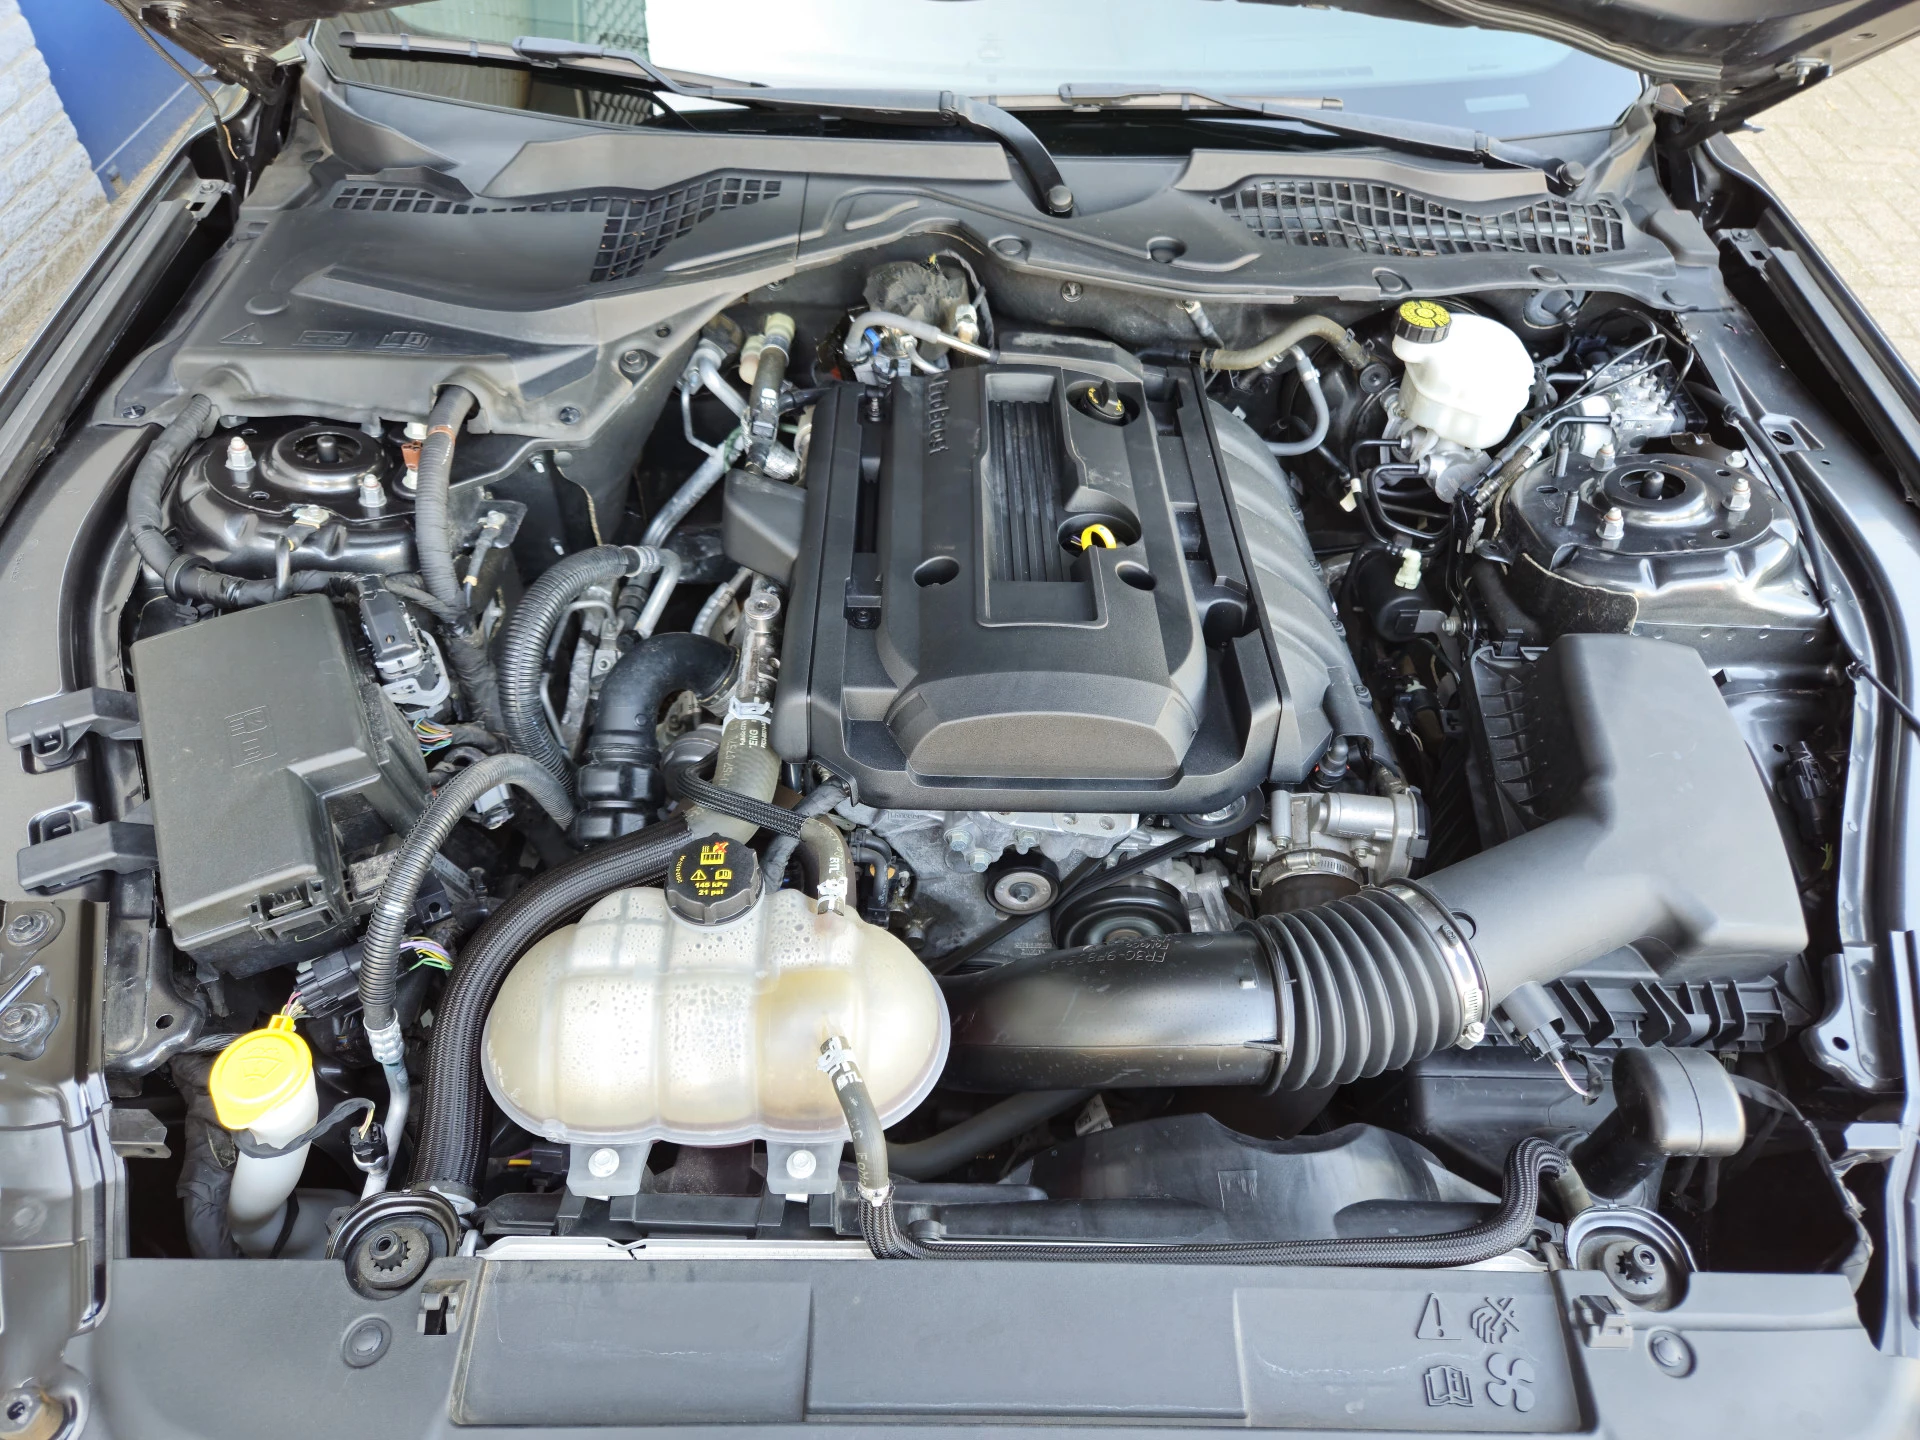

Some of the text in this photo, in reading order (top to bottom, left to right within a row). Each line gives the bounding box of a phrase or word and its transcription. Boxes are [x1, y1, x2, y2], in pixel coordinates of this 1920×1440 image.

[748, 729, 759, 747] ENG
[694, 881, 711, 889] 145
[710, 888, 724, 897] psi
